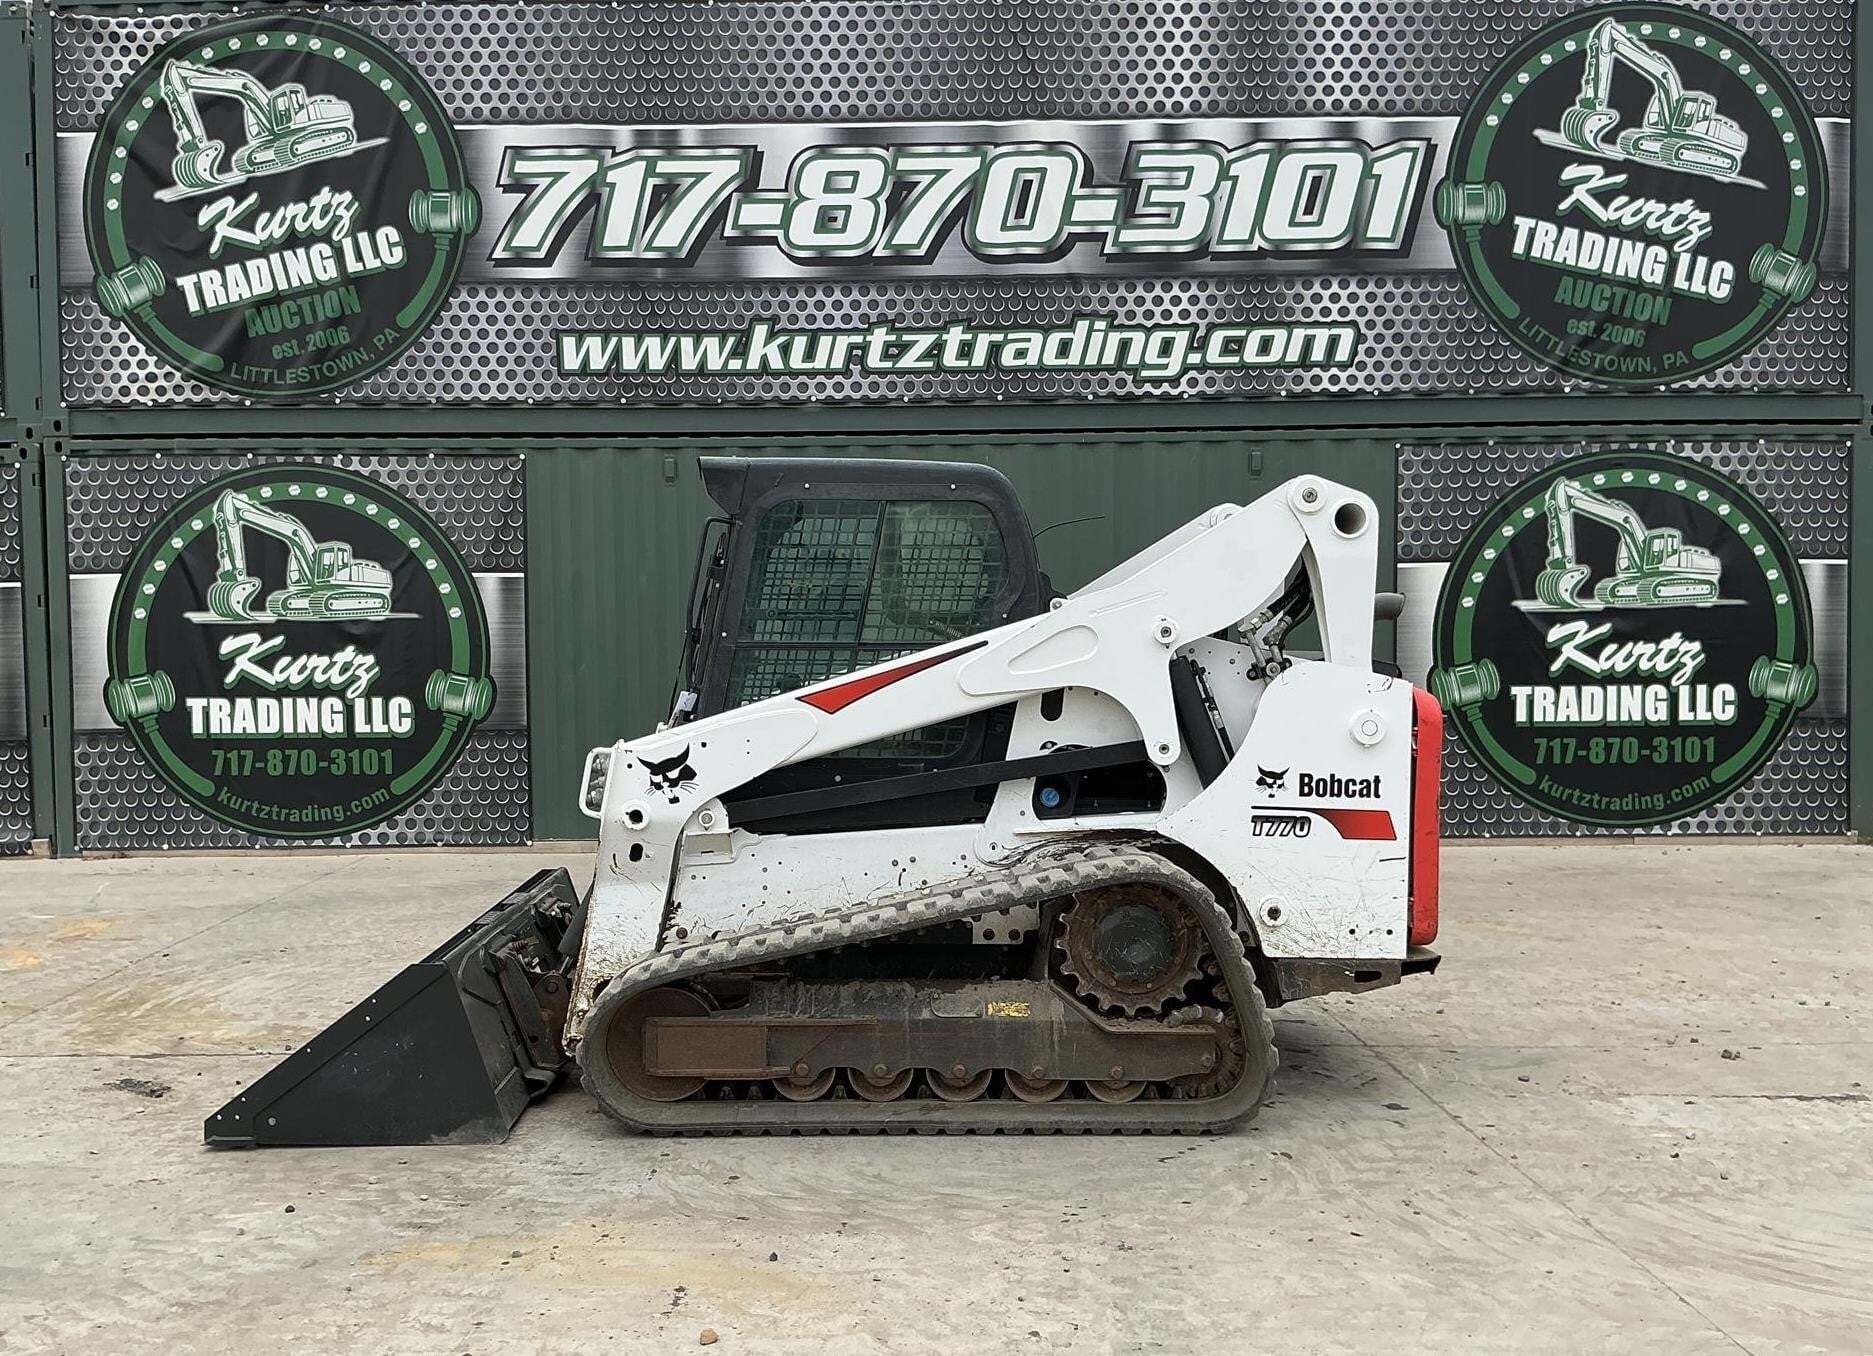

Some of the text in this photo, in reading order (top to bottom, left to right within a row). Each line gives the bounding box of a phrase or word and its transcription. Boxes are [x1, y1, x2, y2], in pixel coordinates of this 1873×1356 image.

[198, 187, 359, 258] Kurtz
[492, 139, 1434, 266] 717-870-3101
[1558, 163, 1712, 251] Kurtz
[176, 226, 406, 315] TRADING LLC
[1512, 216, 1736, 303] TRADING LLC
[244, 285, 361, 338] AUCTION
[1554, 277, 1673, 325] AUCTION
[230, 327, 401, 385] LITTLESTOWN, PA
[272, 326, 350, 360] est. 2006
[555, 315, 1358, 381] www.kurtztrading.com
[1518, 318, 1688, 374] LITTLESTOWN, PA
[1566, 318, 1646, 347] est. 2006
[219, 633, 379, 699] Kurtz
[1547, 620, 1705, 685] Kurtz
[186, 696, 414, 739] TRADING LLC
[1511, 683, 1737, 727] TRADING LLC
[212, 748, 393, 776] 717-870-3101
[1534, 737, 1715, 765] 717-870-3101
[217, 787, 391, 822] kurtztrading.com
[1299, 773, 1381, 799] Bobcat
[1539, 776, 1711, 811] kurtztrading.com
[1251, 815, 1311, 838] T770
